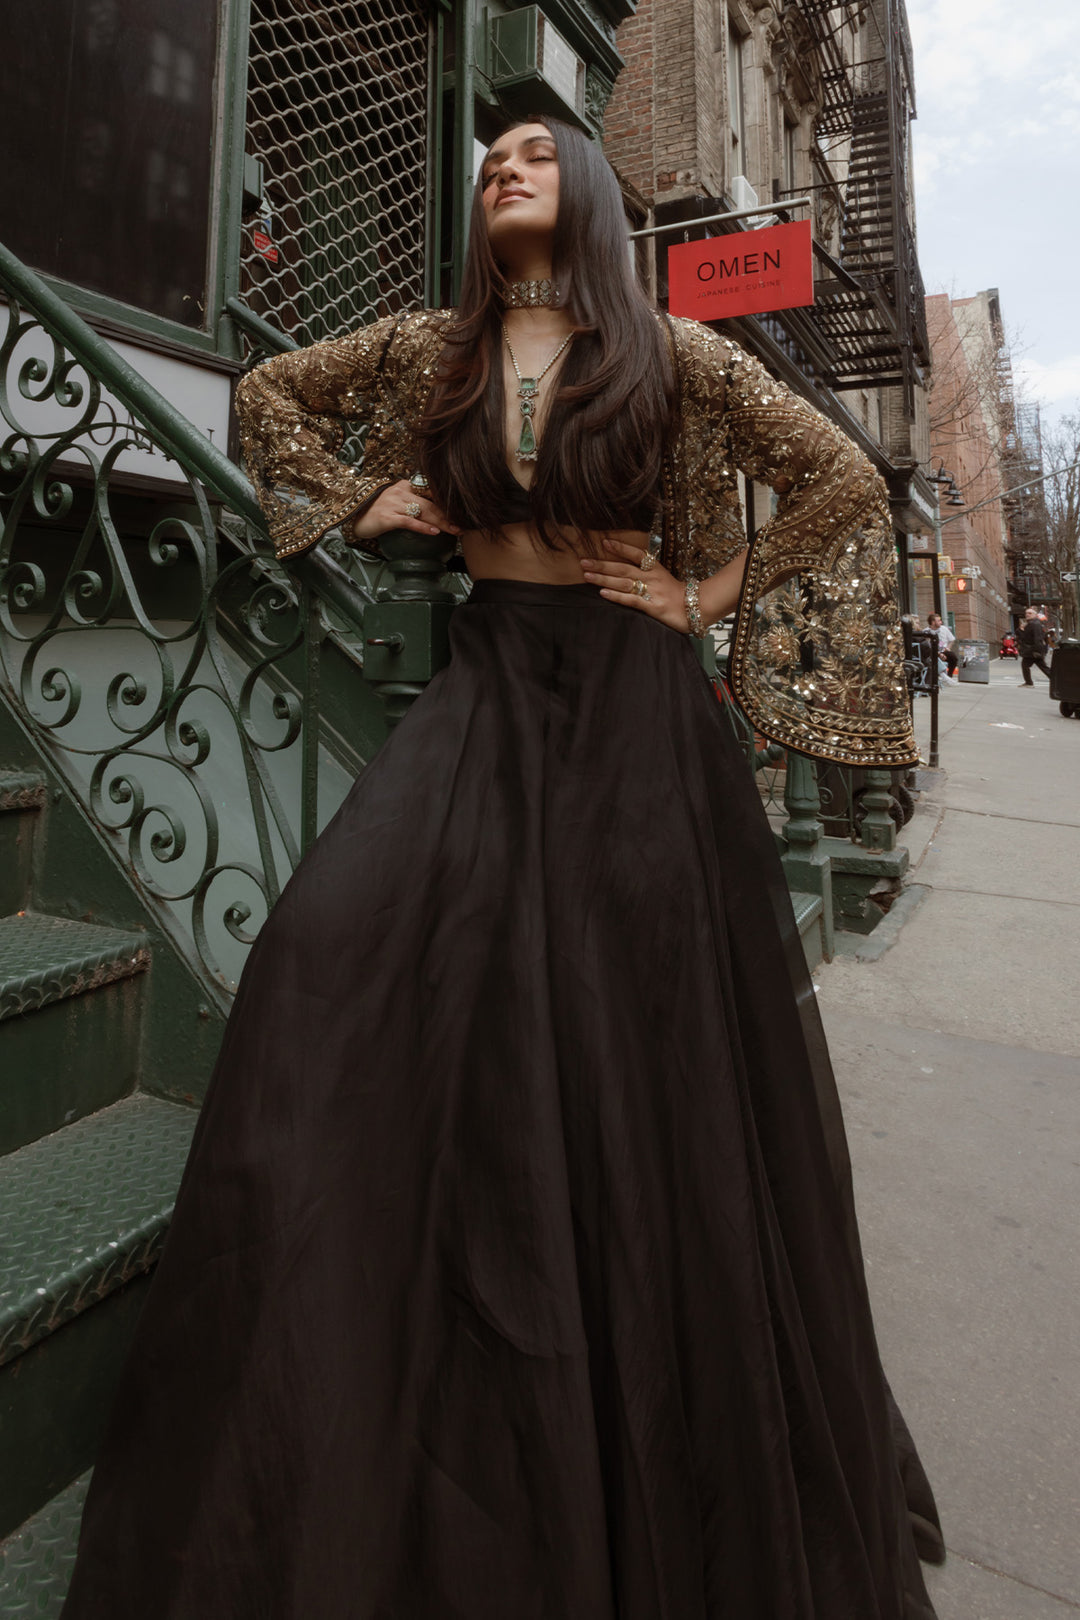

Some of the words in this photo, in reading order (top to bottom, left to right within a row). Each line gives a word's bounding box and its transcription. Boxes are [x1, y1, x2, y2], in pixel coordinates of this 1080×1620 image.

[697, 249, 780, 282] OMEN
[697, 286, 740, 299] JAPANESE
[745, 279, 780, 291] CUISINE
